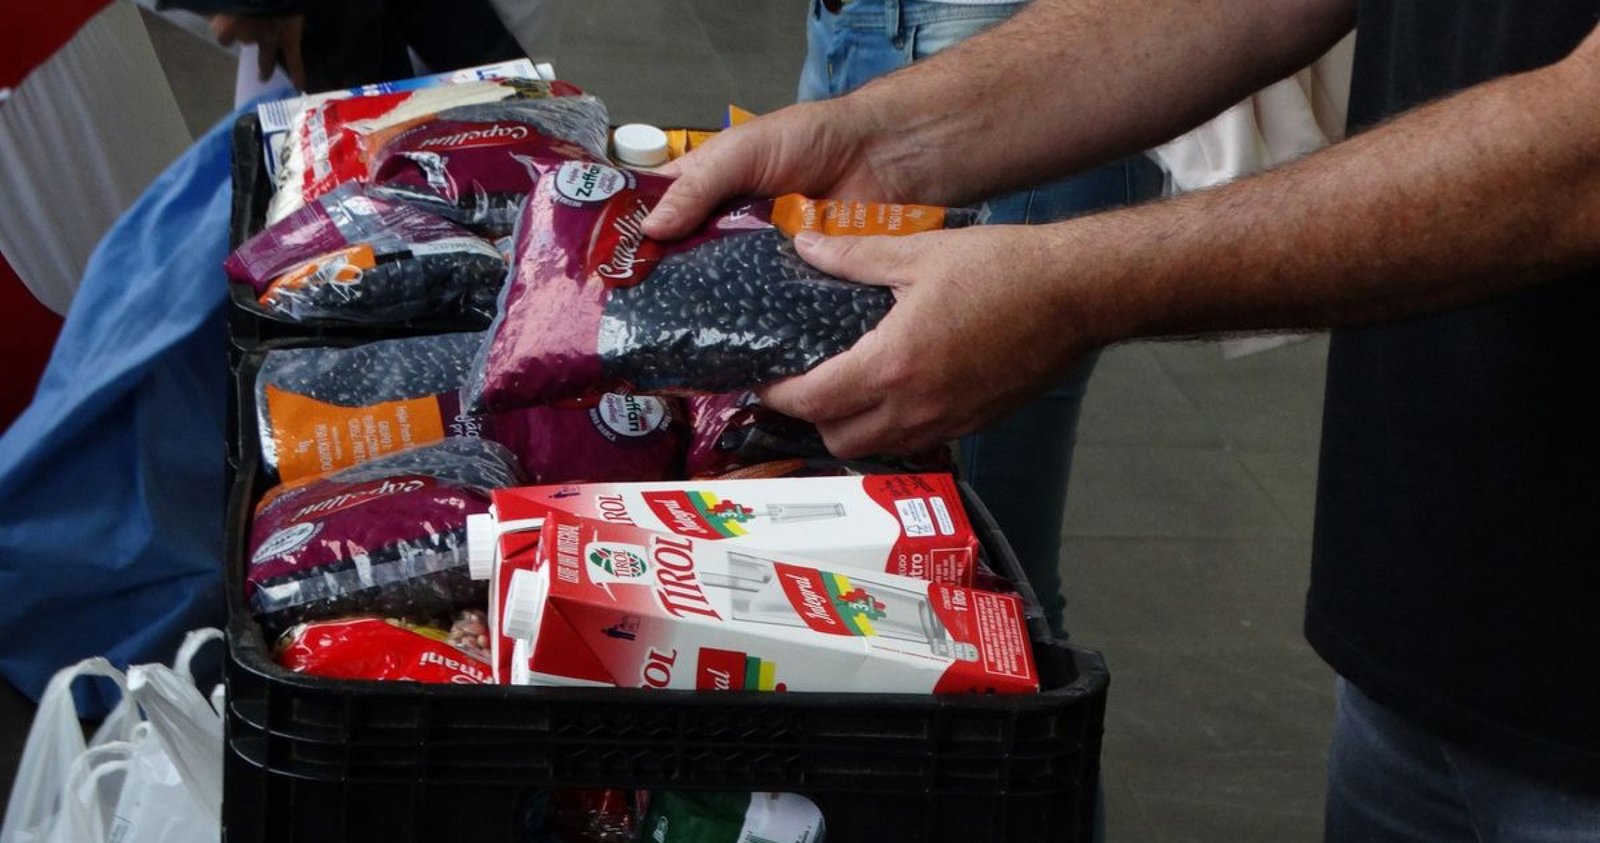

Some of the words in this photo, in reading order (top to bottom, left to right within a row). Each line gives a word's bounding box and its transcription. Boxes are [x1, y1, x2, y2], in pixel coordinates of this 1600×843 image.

[418, 124, 528, 150] Capellini
[574, 164, 601, 198] Zaffa
[597, 198, 651, 279] Capellini
[624, 393, 641, 432] affari
[599, 493, 638, 527] ROL
[653, 499, 708, 535] Integral
[614, 549, 632, 579] TIROL
[654, 536, 724, 622] TIROL
[909, 553, 925, 577] tro
[784, 573, 837, 626] Integral
[419, 651, 484, 681] mani
